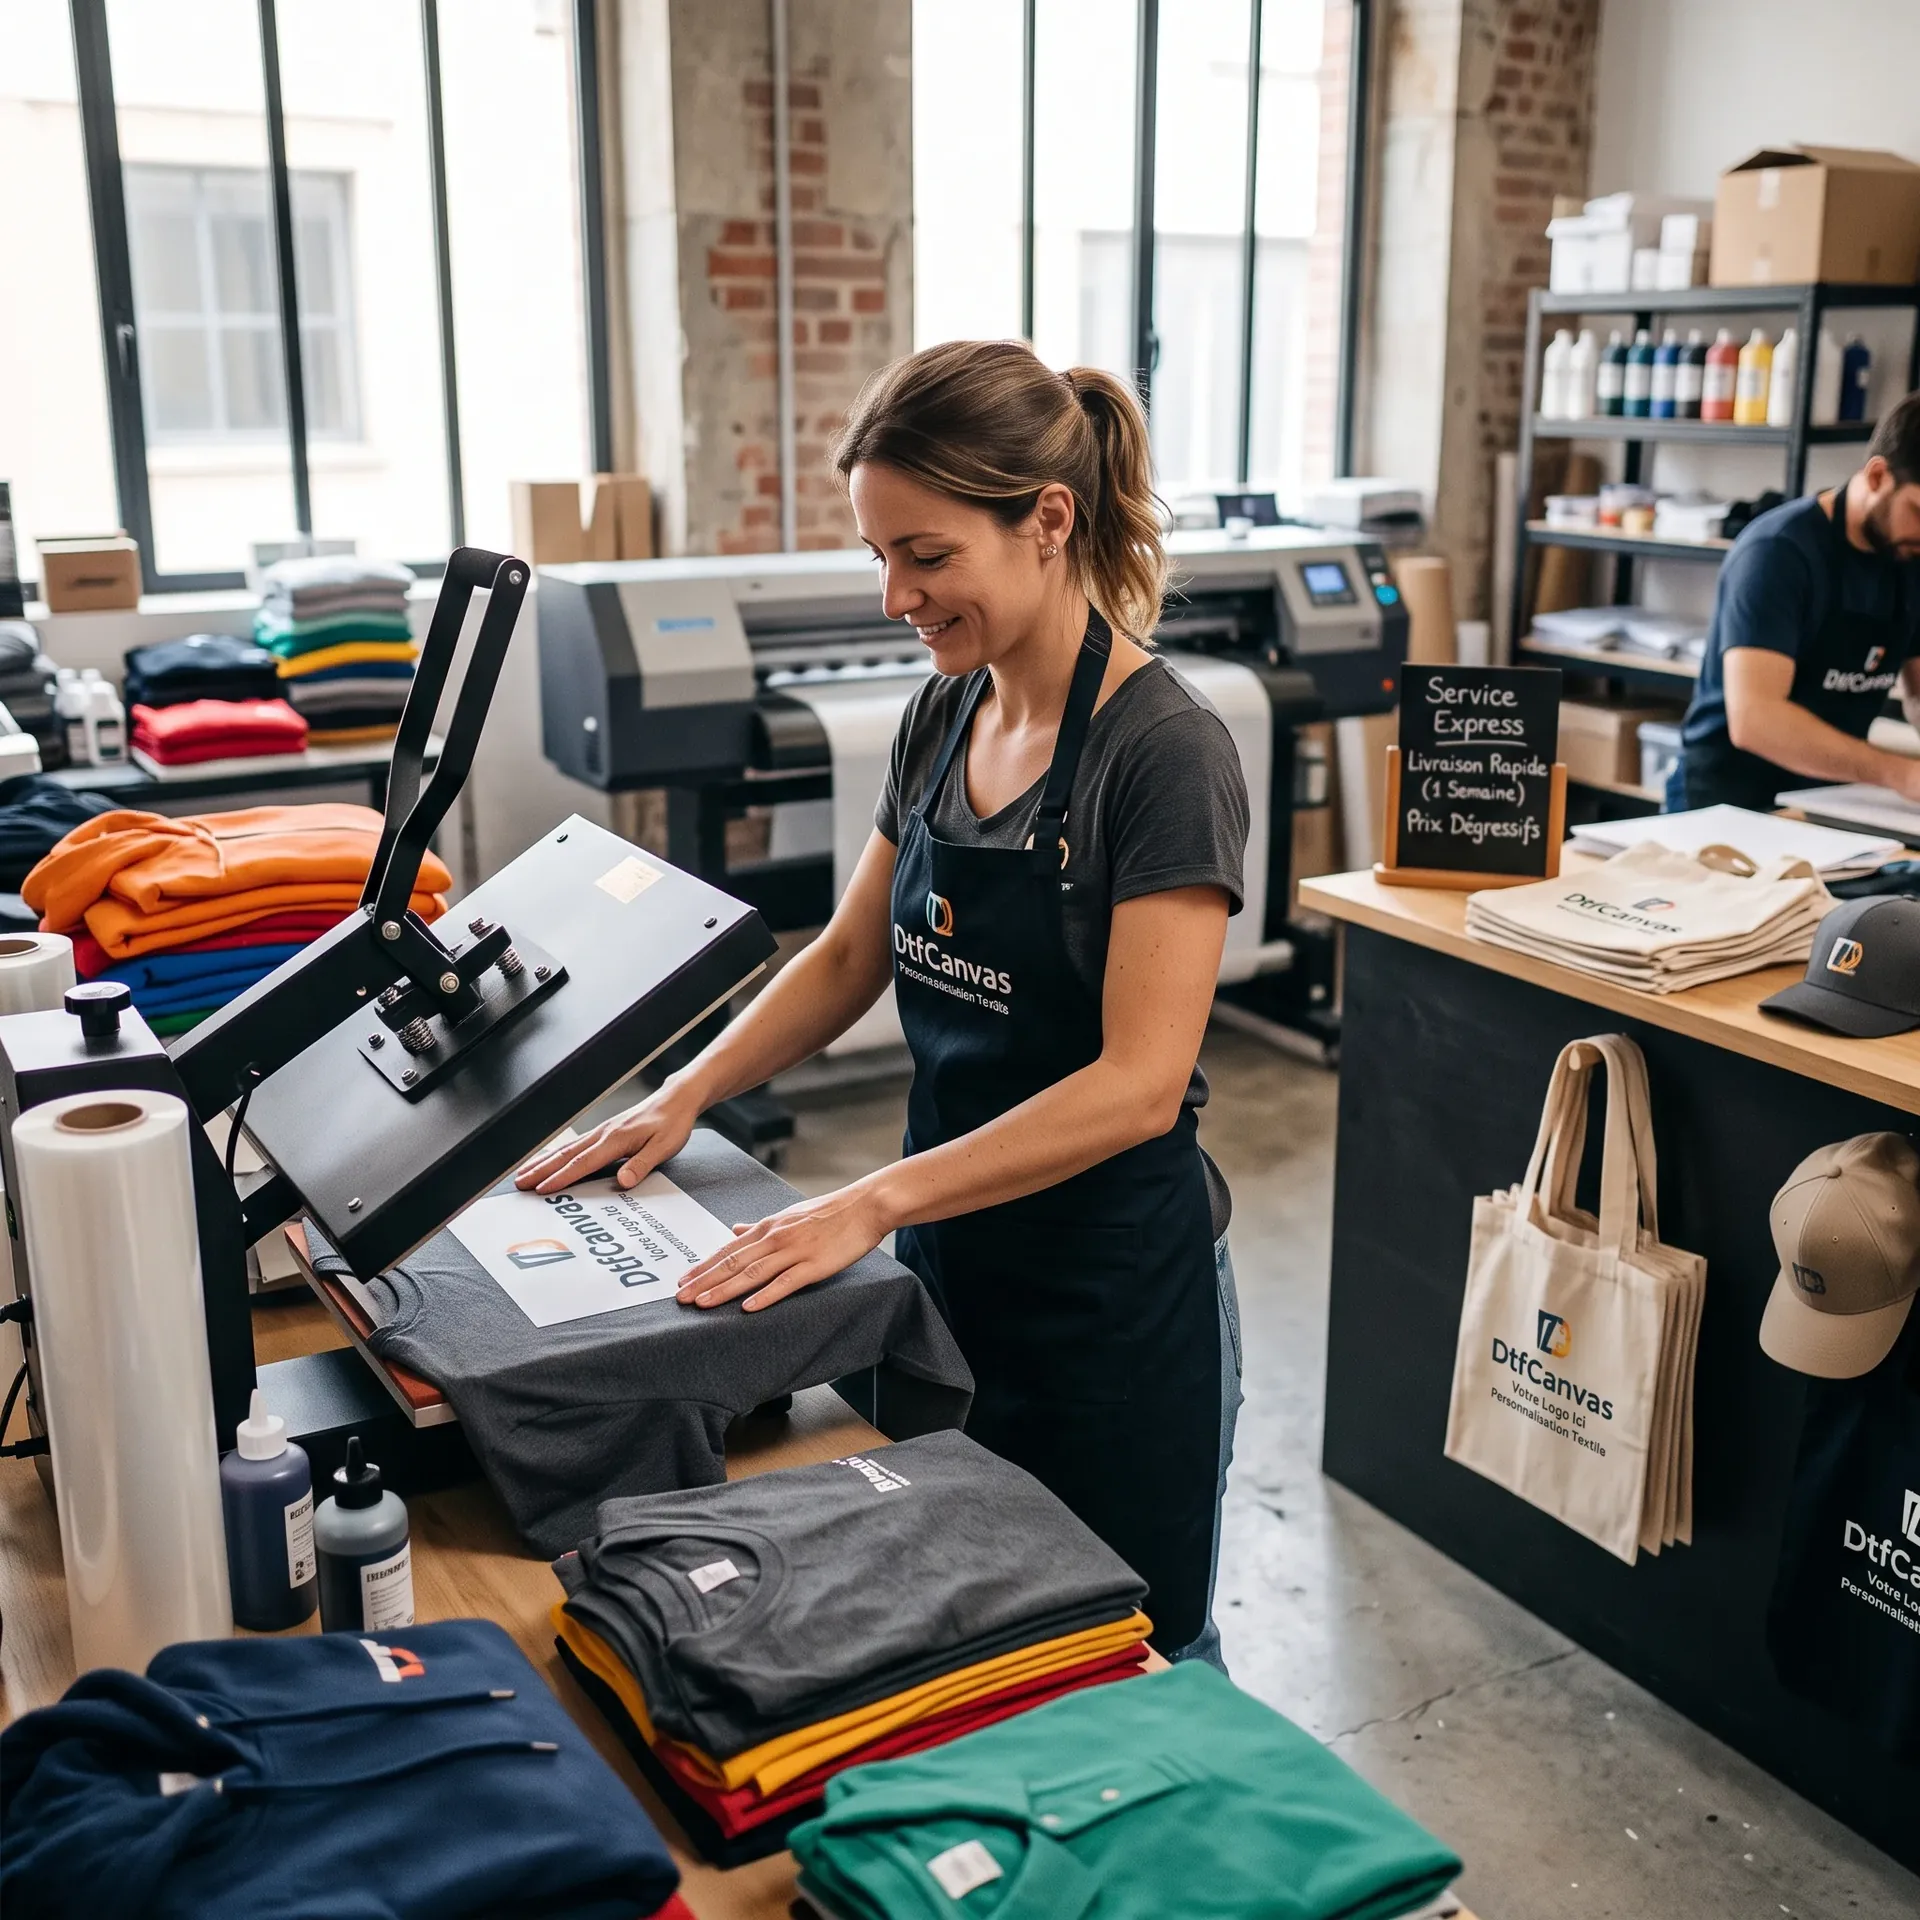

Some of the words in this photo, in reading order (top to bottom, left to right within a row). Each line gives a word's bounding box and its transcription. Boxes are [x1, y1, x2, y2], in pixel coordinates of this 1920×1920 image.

[1425, 676, 1518, 707] Service
[1433, 709, 1524, 741] Express
[1408, 750, 1483, 773] Livraison
[1490, 753, 1548, 782] Rapide
[1421, 776, 1442, 802] (1
[1447, 780, 1526, 807] Semaine)
[1407, 808, 1443, 833] Prix
[1450, 812, 1541, 846] Dégressifs
[893, 923, 1012, 995] DtfCanvas
[544, 1194, 660, 1288] DtfCanvas
[616, 1216, 643, 1238] Logo
[638, 1237, 669, 1262] Votre
[1492, 1337, 1614, 1421] DtfCanvas
[1491, 1387, 1569, 1438] Personnalisation
[1572, 1429, 1606, 1457] Textile
[1511, 1380, 1540, 1405] Votre
[1542, 1397, 1570, 1421] Logo
[1572, 1412, 1586, 1429] Ici
[1867, 1570, 1901, 1601] Votre
[1904, 1593, 1920, 1616] Lo
